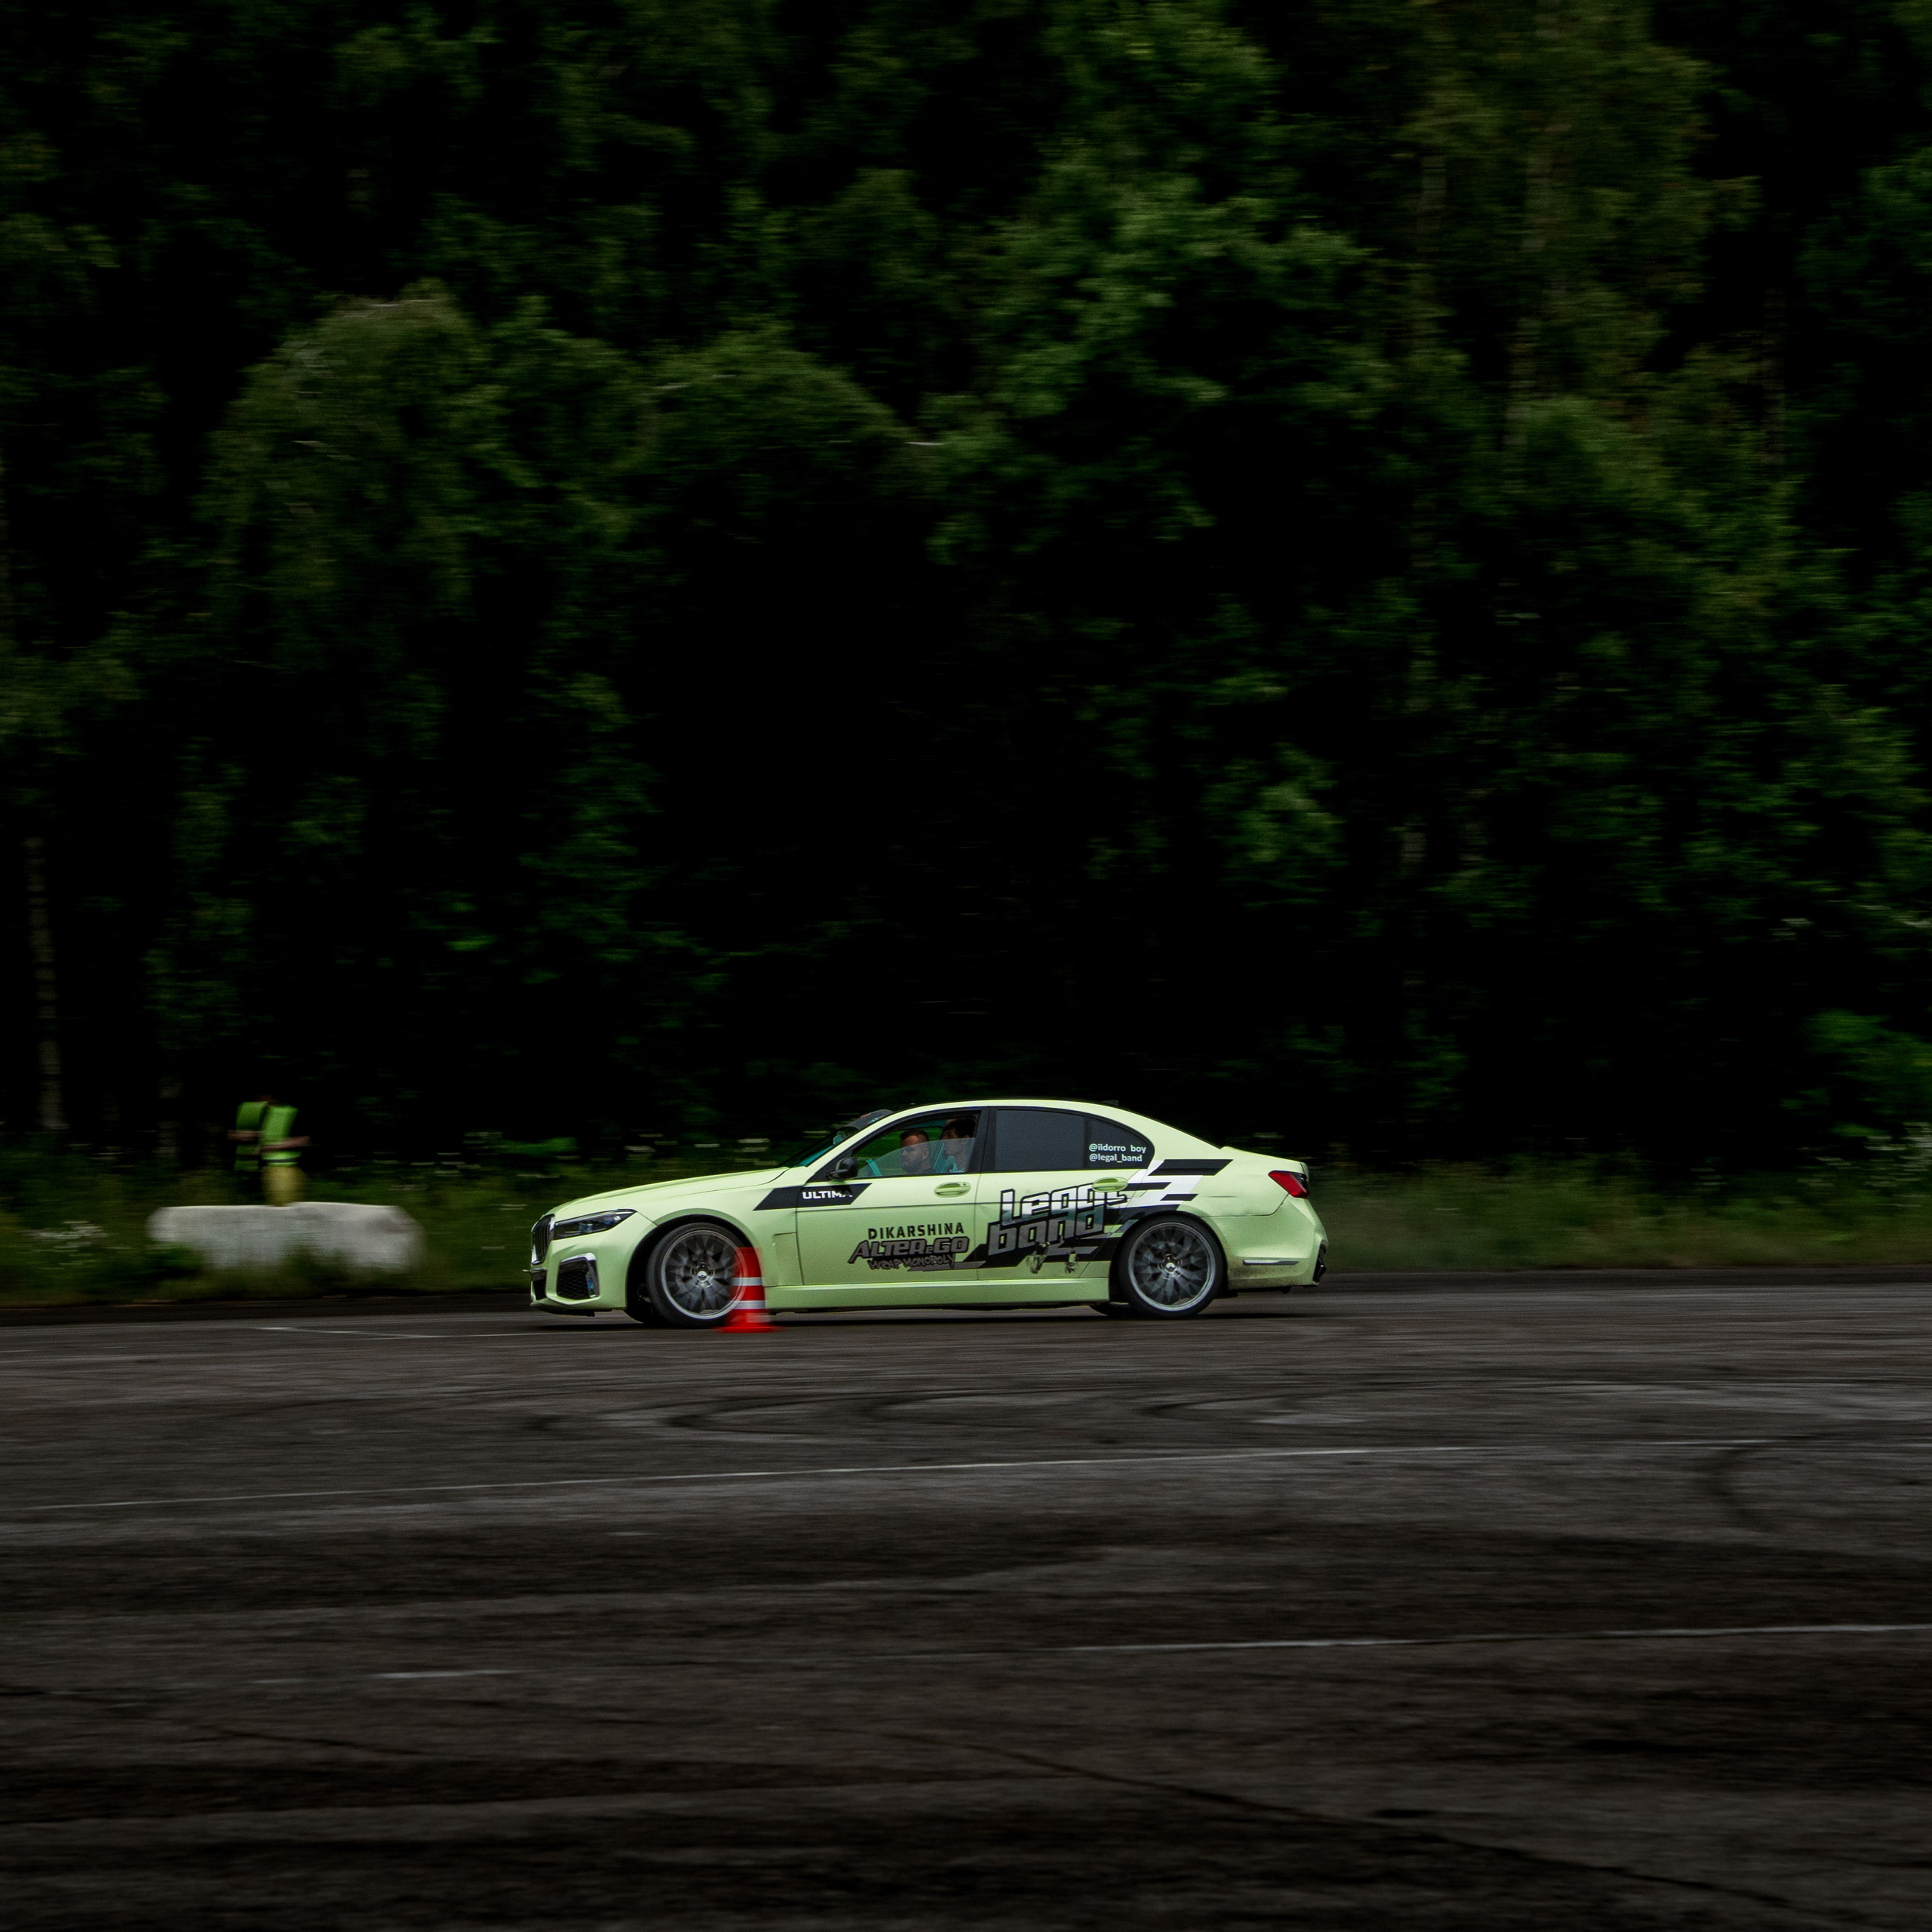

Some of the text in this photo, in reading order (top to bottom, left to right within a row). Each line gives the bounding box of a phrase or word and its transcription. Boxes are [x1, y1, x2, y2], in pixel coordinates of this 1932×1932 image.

[1130, 1144, 1146, 1154] boy
[1089, 1153, 1143, 1163] @legal_band
[868, 1222, 964, 1240] DIKARSHINA
